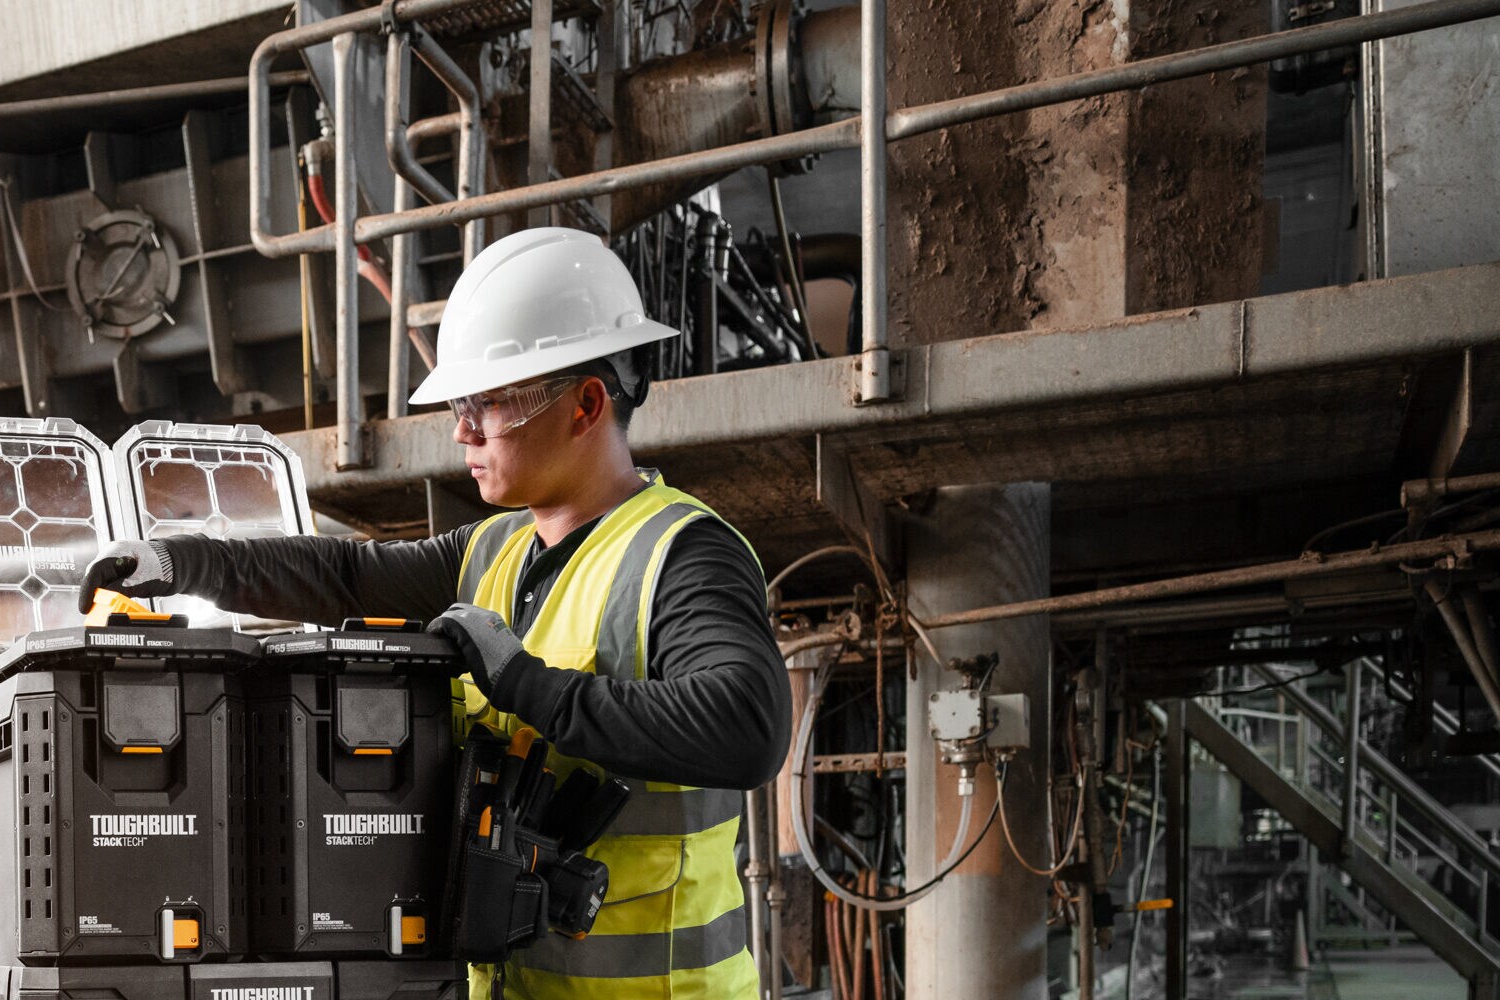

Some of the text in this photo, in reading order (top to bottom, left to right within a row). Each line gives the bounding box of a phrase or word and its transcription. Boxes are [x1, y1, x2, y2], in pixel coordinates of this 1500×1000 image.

[89, 633, 146, 646] TOUGHBUILT
[331, 638, 384, 651] TOUGHBUILT
[90, 814, 196, 836] TOUGHBUILT
[323, 814, 423, 836] TOUGHBUILT
[92, 836, 145, 847] STACKTECH
[325, 835, 375, 846] STACKTECH
[79, 915, 98, 925] IP65
[312, 912, 331, 922] IP65
